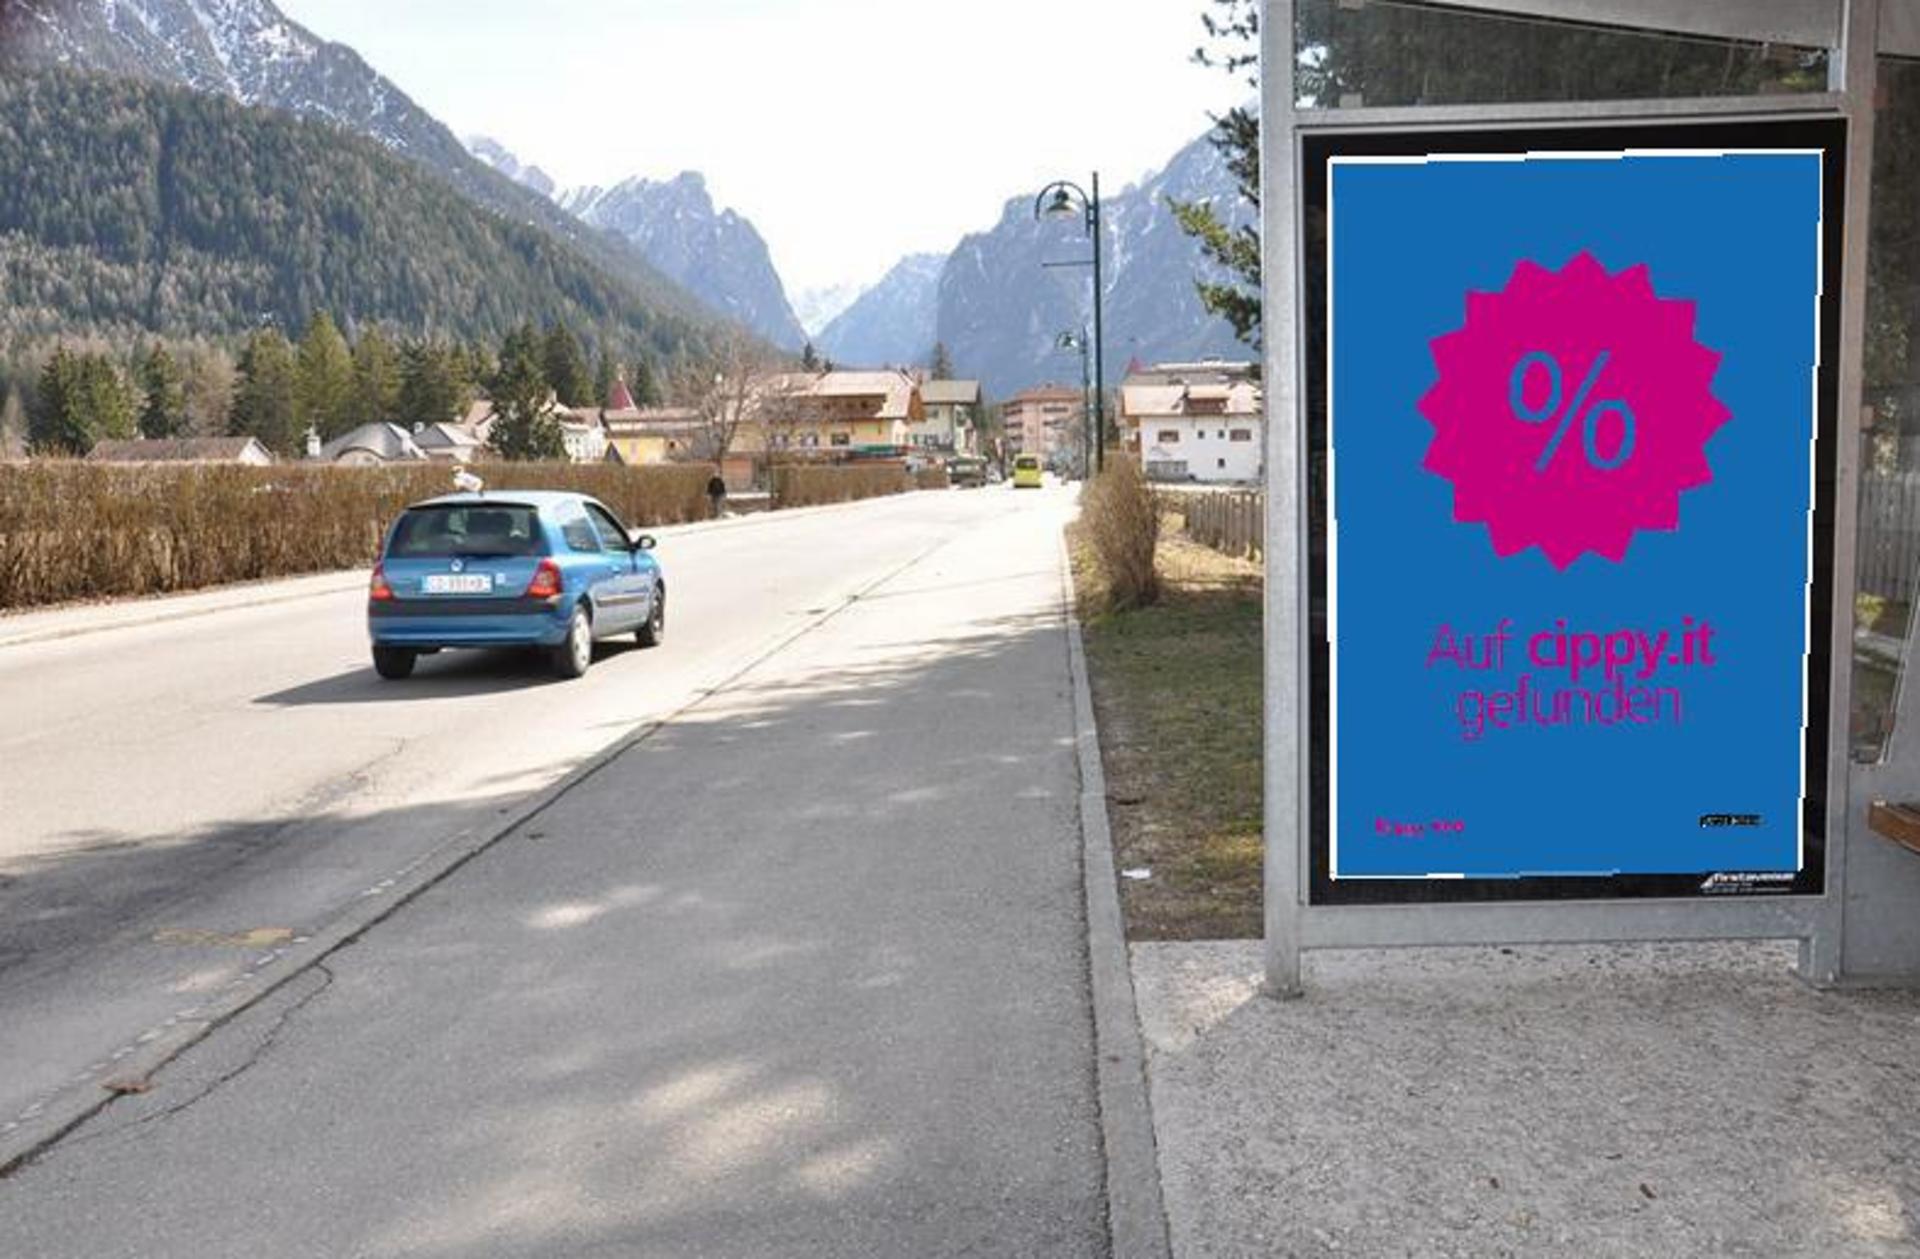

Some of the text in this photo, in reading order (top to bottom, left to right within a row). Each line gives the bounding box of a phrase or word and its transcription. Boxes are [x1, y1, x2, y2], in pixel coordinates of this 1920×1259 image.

[1508, 349, 1636, 473] %
[1425, 615, 1717, 682] Auf cippy.it
[1457, 672, 1682, 742] gefunden
